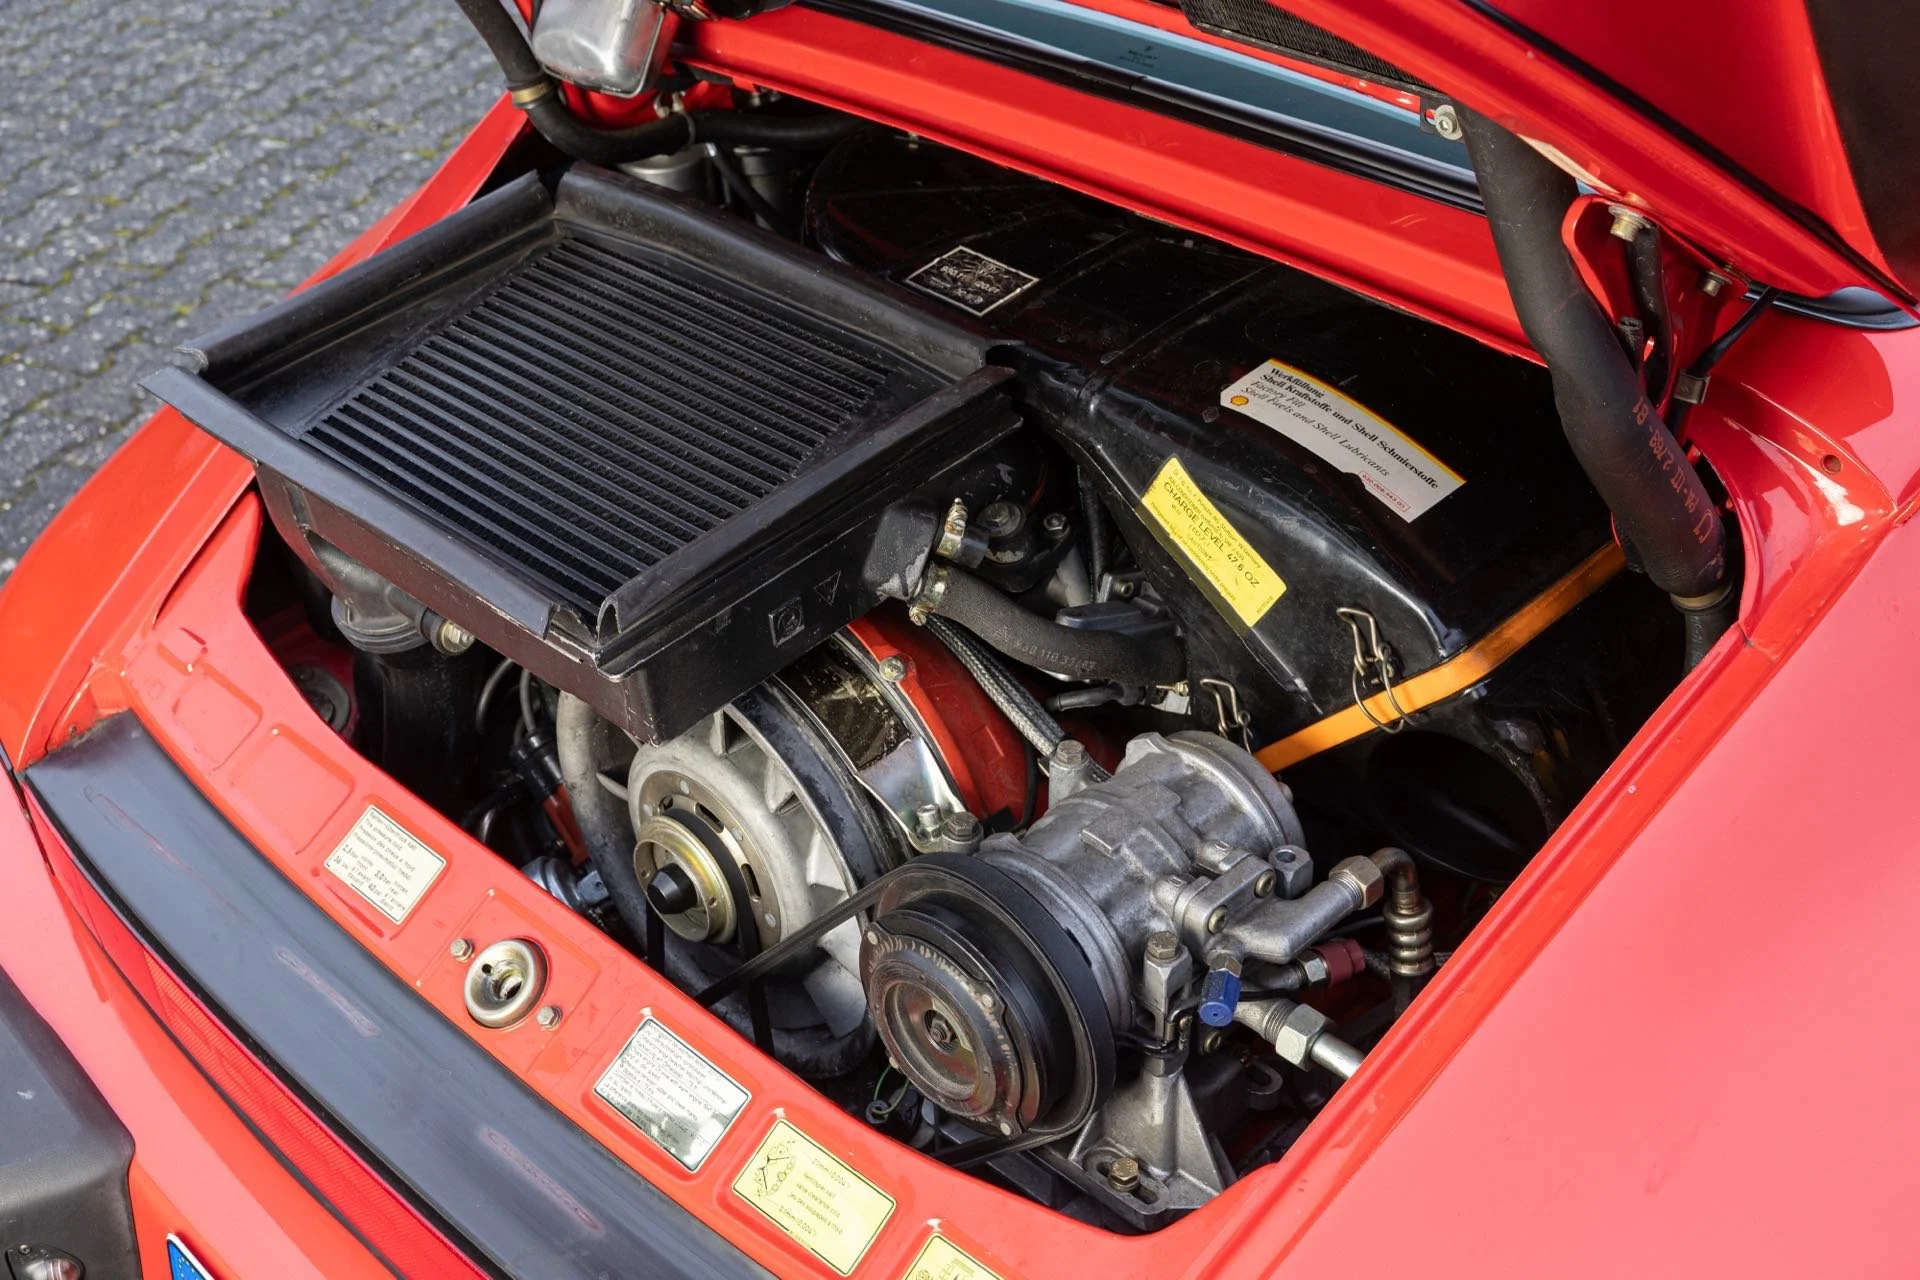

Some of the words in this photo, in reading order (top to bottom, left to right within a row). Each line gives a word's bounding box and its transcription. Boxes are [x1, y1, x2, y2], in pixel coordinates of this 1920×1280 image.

[1251, 380, 1284, 400] Factory
[1270, 368, 1326, 398] Werkfüllung
[1241, 386, 1266, 402] Shell
[1267, 398, 1293, 416] Fuels
[1292, 411, 1314, 424] and
[1312, 422, 1340, 440] Shell
[1338, 436, 1390, 477] Lubricants
[1260, 373, 1286, 389] Shell
[1285, 384, 1332, 413] Kraftstoffe
[1332, 410, 1352, 424] und
[1351, 422, 1379, 442] Shell
[1377, 440, 1439, 490] Schmierstoffe
[1162, 480, 1200, 524] CHARGE
[1198, 520, 1227, 553] LEVEL
[1242, 569, 1260, 589] OZ
